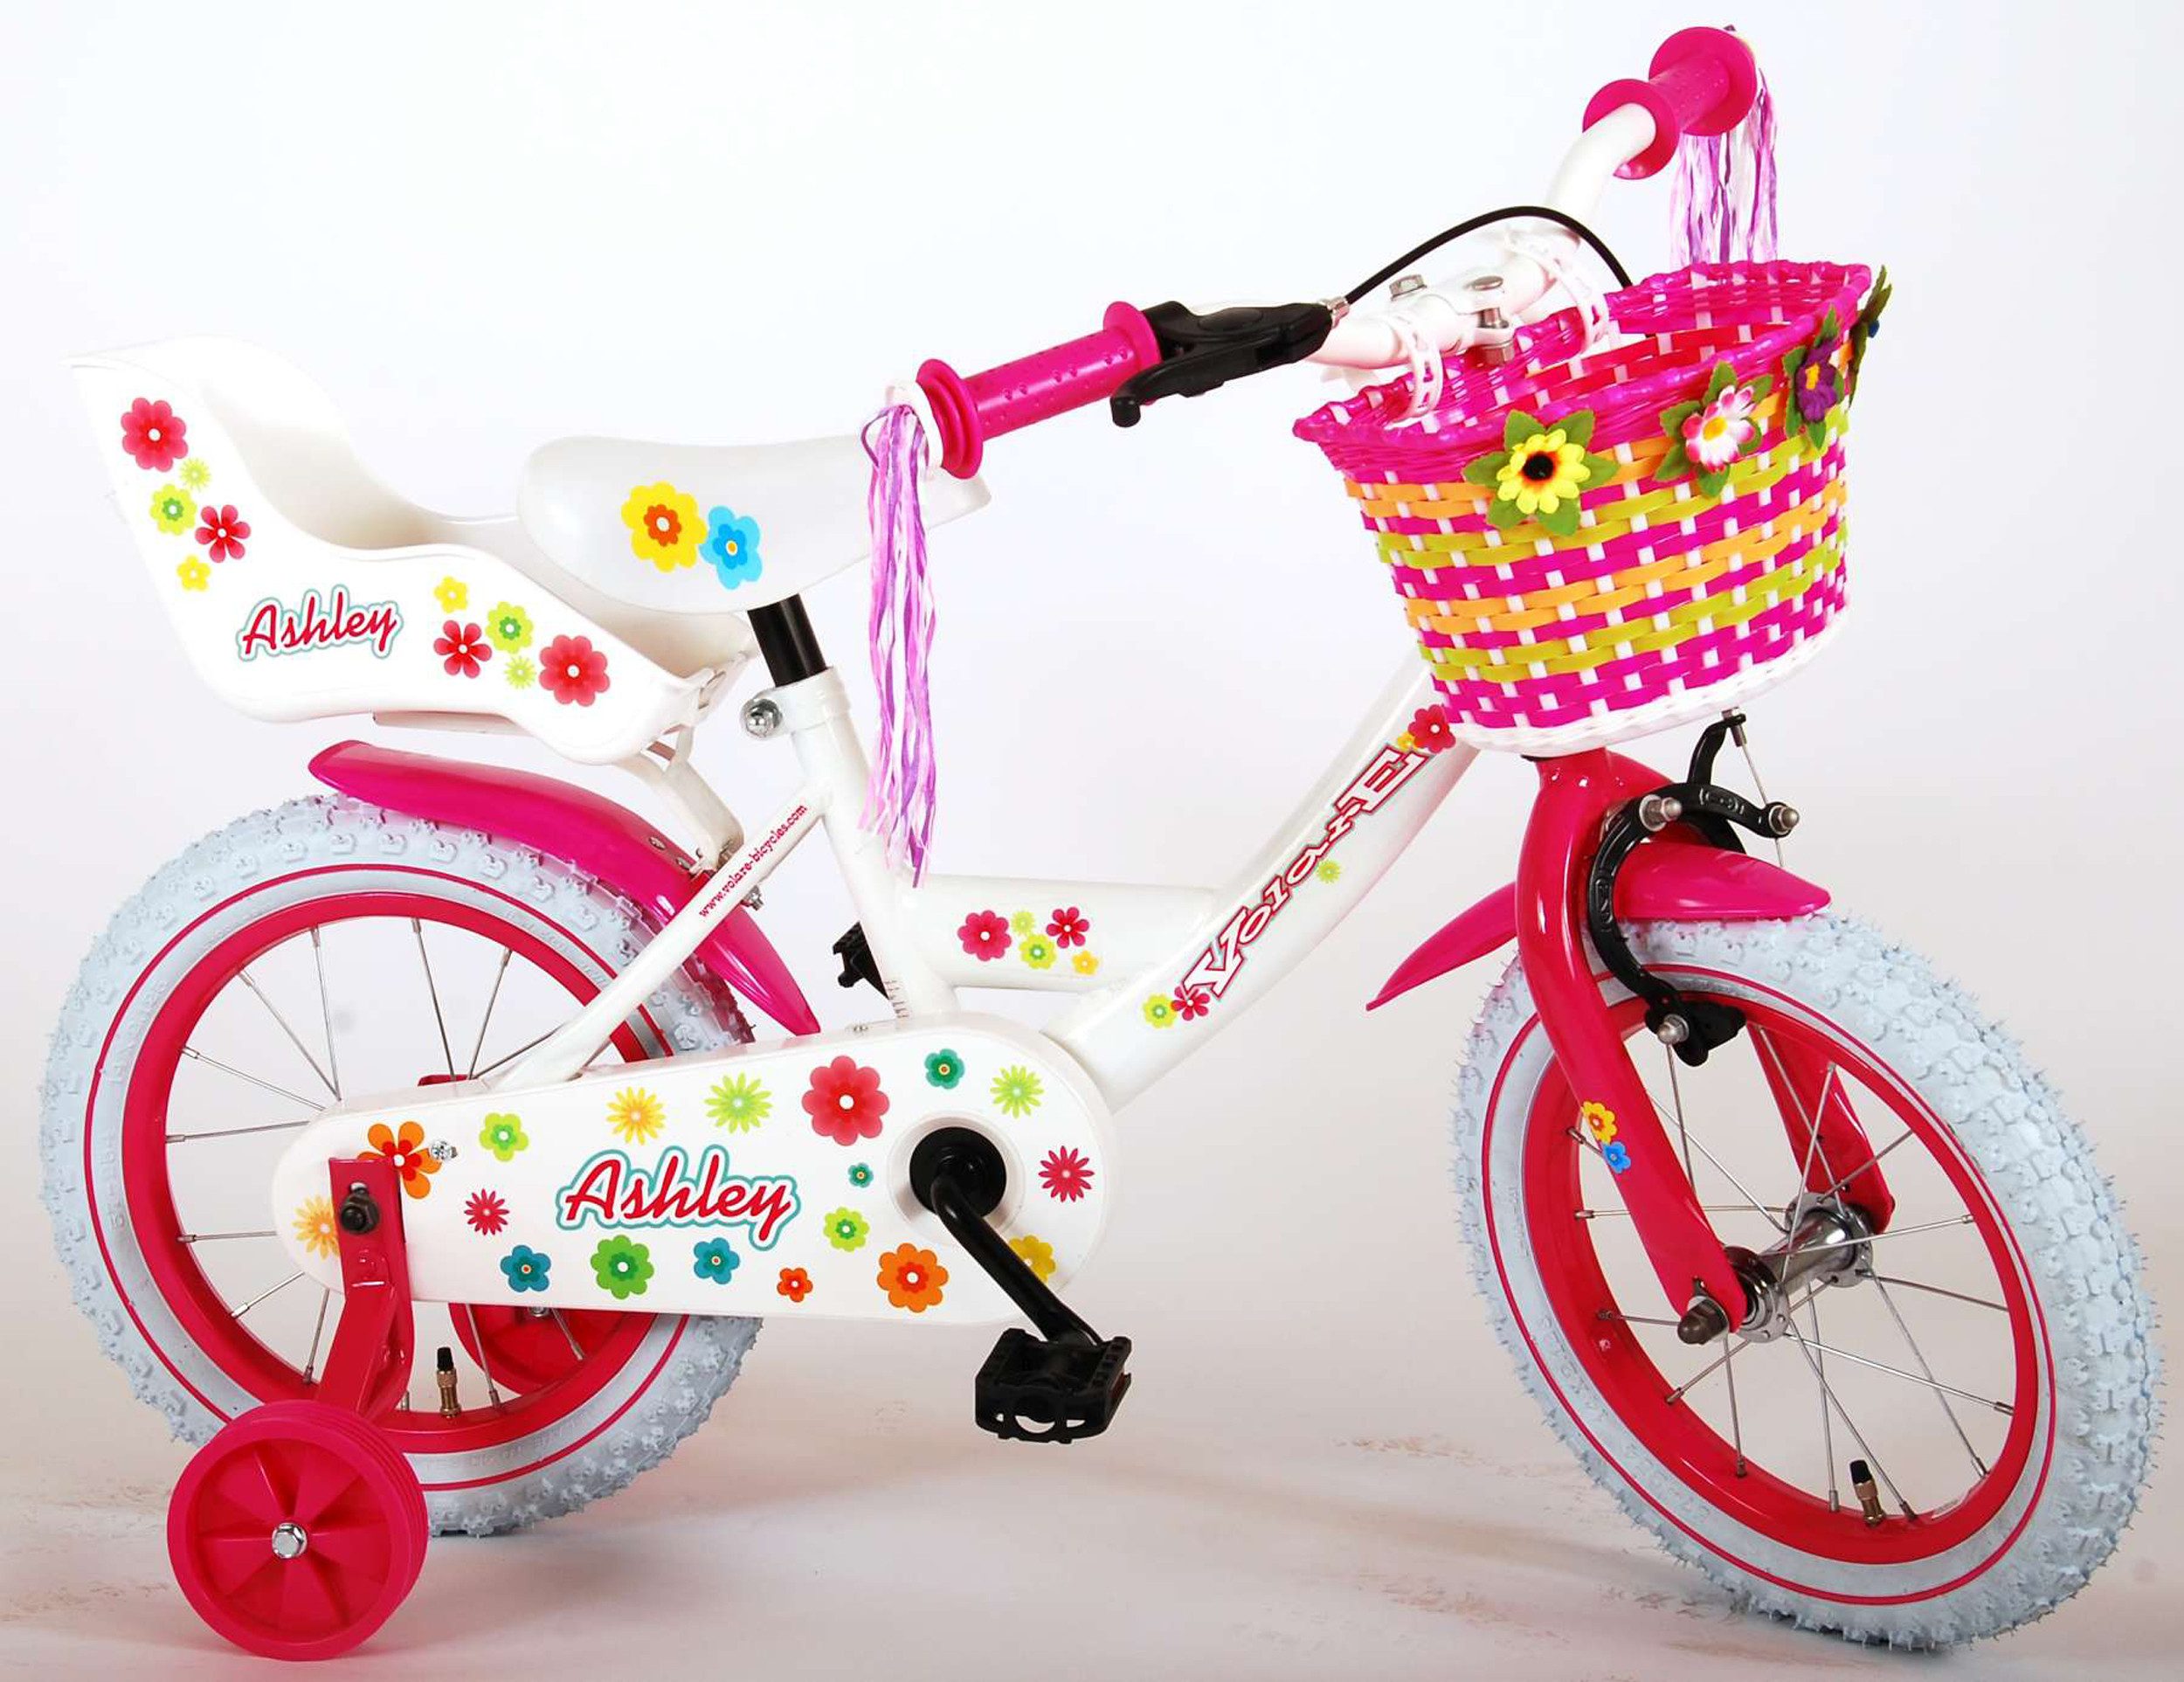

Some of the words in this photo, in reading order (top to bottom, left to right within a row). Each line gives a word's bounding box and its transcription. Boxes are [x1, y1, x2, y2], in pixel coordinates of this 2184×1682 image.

[242, 591, 397, 654] Ashley
[699, 805, 807, 917] www.volare-bicycles.com
[565, 1153, 791, 1242] Ashley
